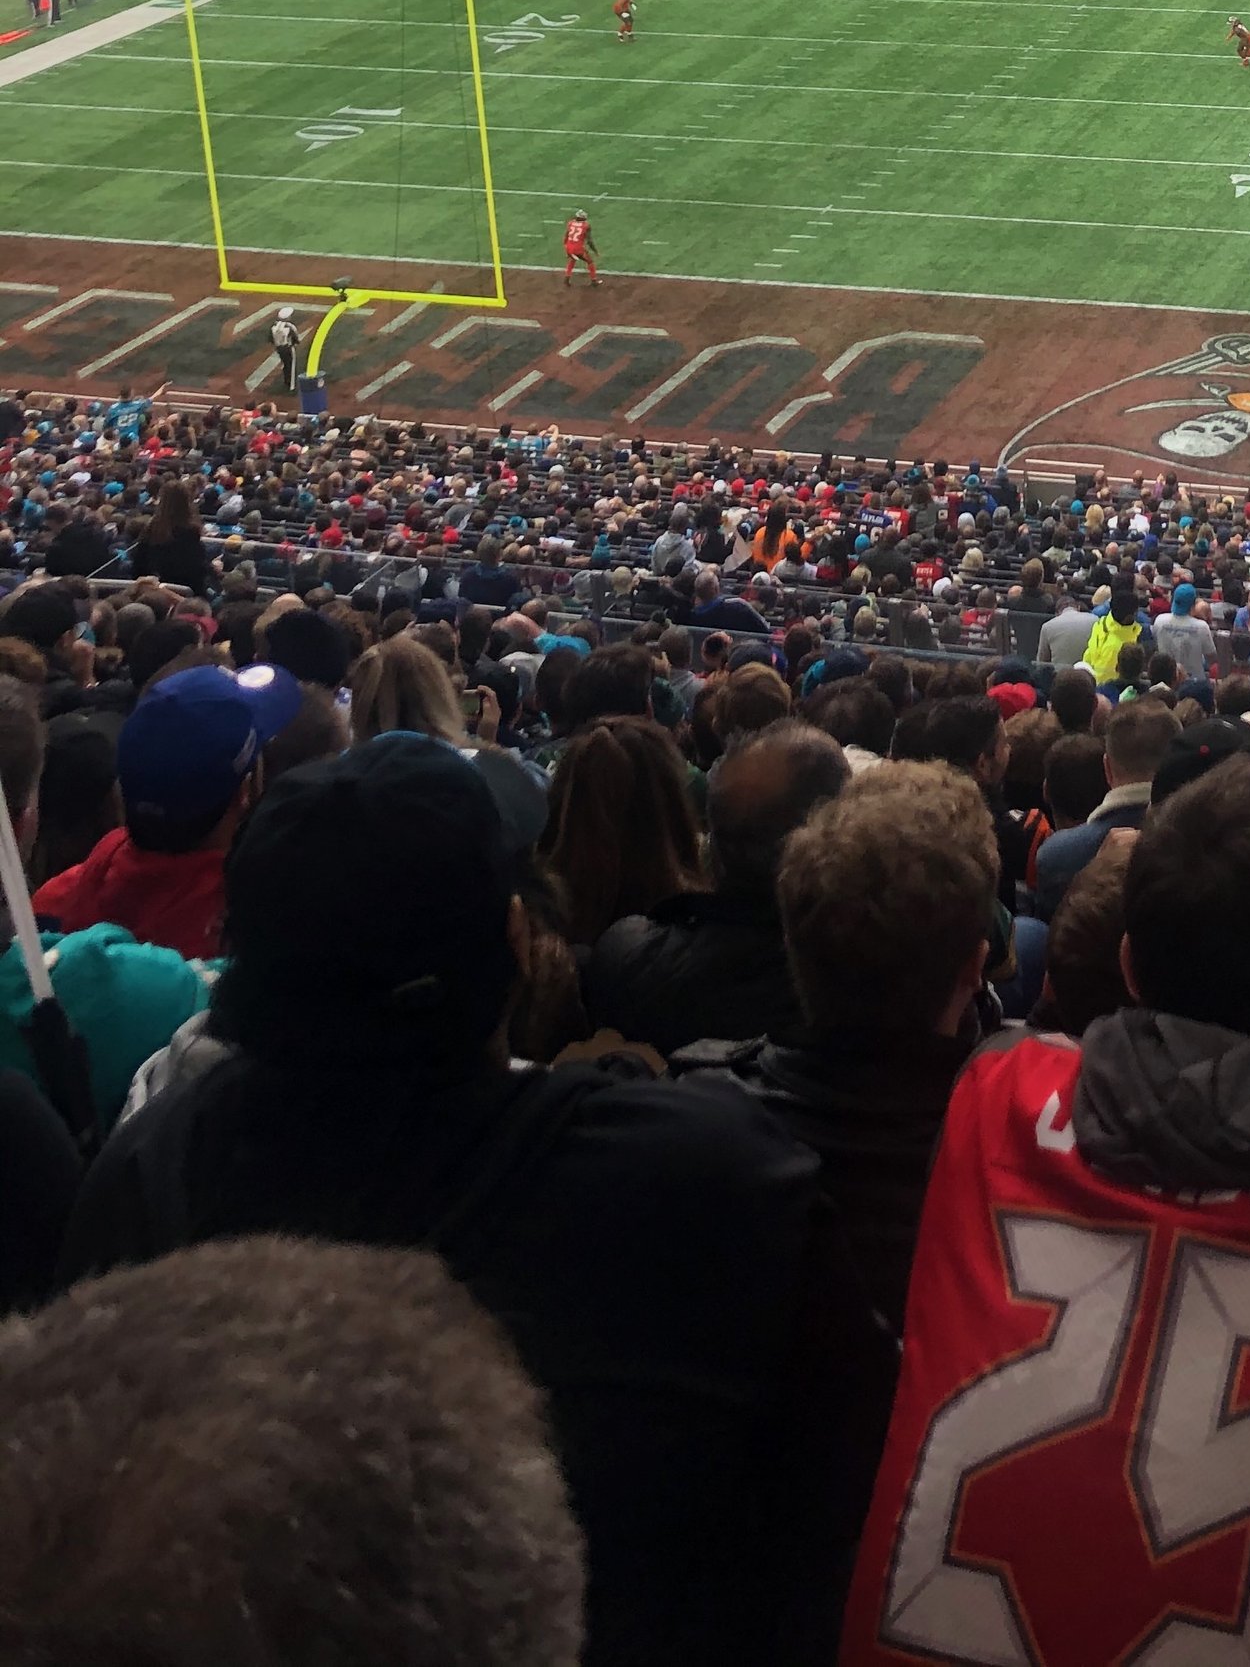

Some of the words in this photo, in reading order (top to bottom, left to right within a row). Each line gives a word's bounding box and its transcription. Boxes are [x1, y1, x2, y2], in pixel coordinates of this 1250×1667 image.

[482, 11, 582, 47] 20
[294, 105, 405, 142] 10
[568, 226, 583, 242] 22
[861, 513, 885, 525] TAYLOR
